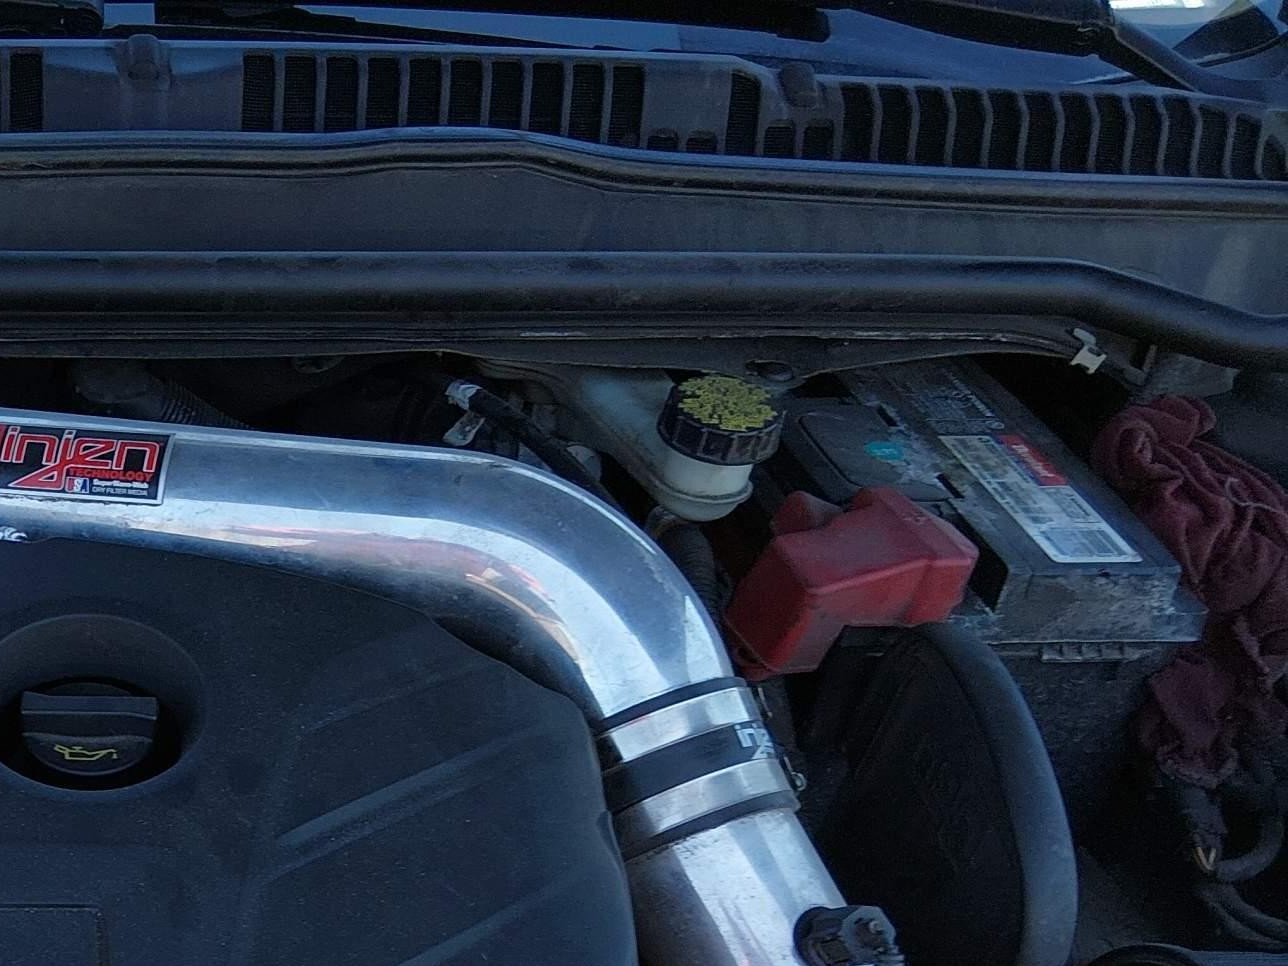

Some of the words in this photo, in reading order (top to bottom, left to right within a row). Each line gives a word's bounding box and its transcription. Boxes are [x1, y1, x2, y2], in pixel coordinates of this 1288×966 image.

[0, 426, 160, 491] injen
[69, 467, 153, 482] TECHNOLOGY
[65, 477, 89, 493] USA
